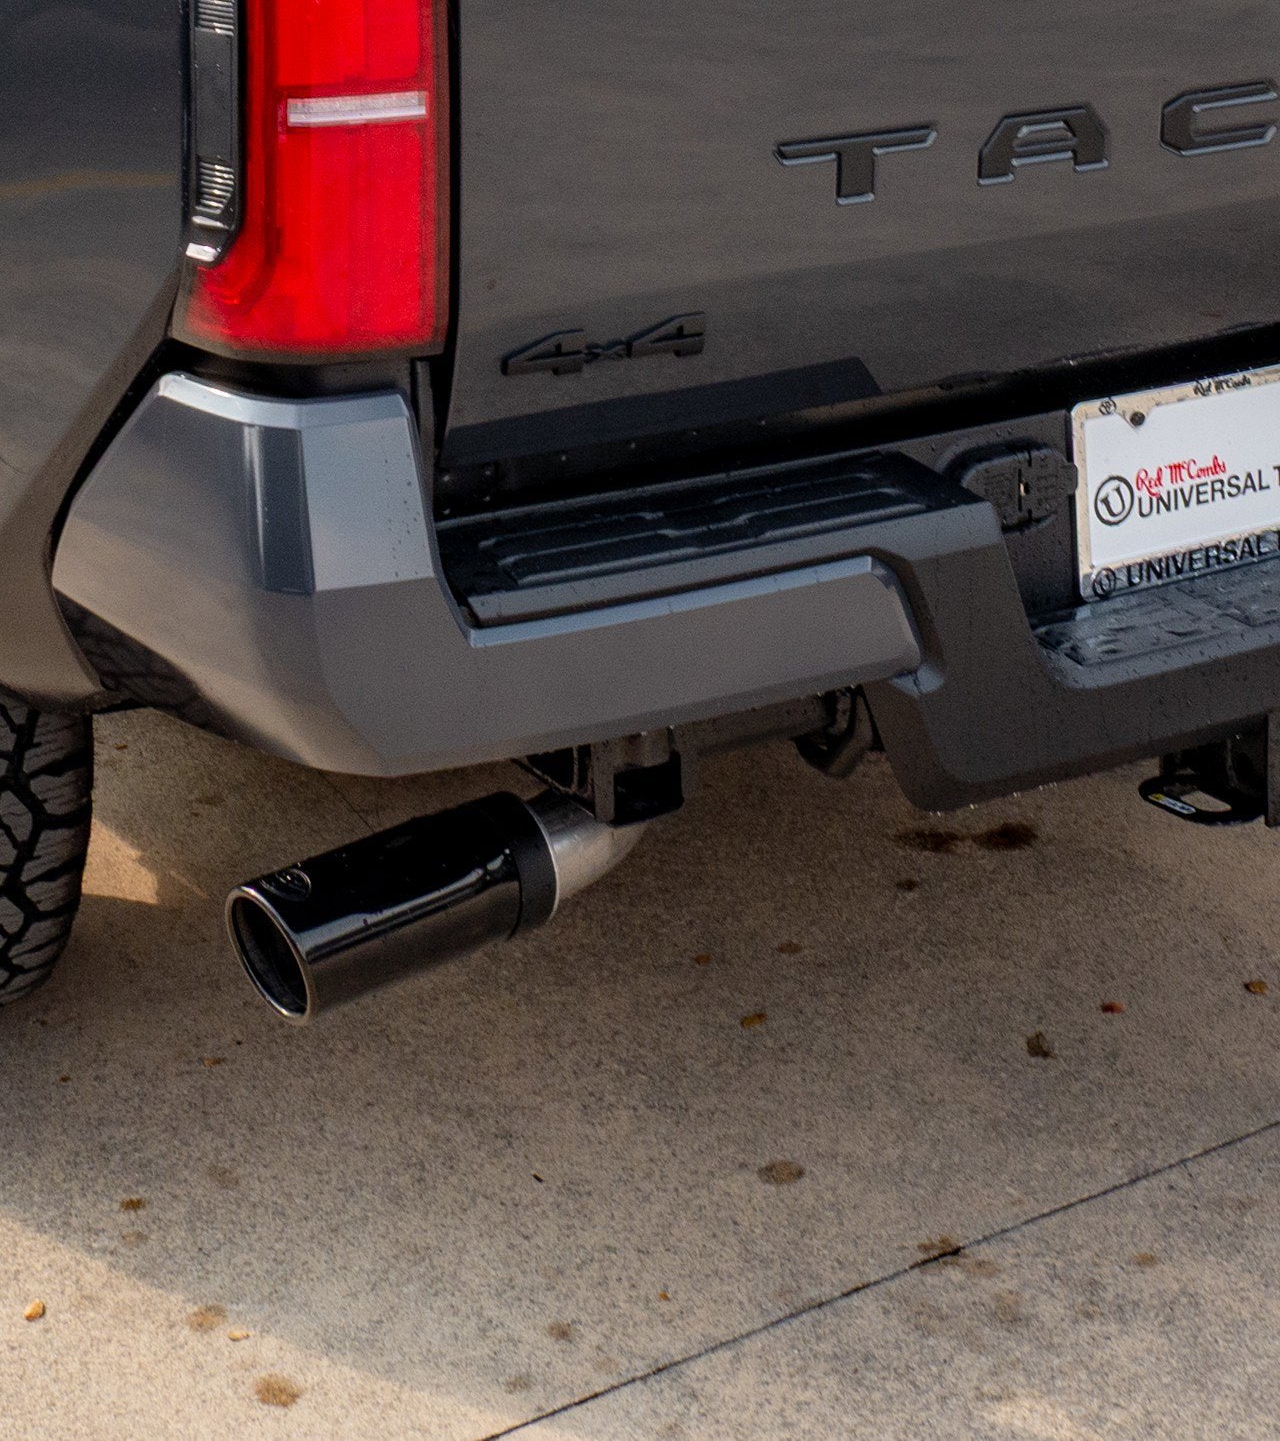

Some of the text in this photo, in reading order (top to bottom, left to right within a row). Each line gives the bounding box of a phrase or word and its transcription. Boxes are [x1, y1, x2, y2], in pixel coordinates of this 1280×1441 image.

[1136, 466, 1163, 497] Red
[1138, 469, 1270, 518] UNIVERSAL
[1125, 534, 1269, 588] UNIVERSAL
